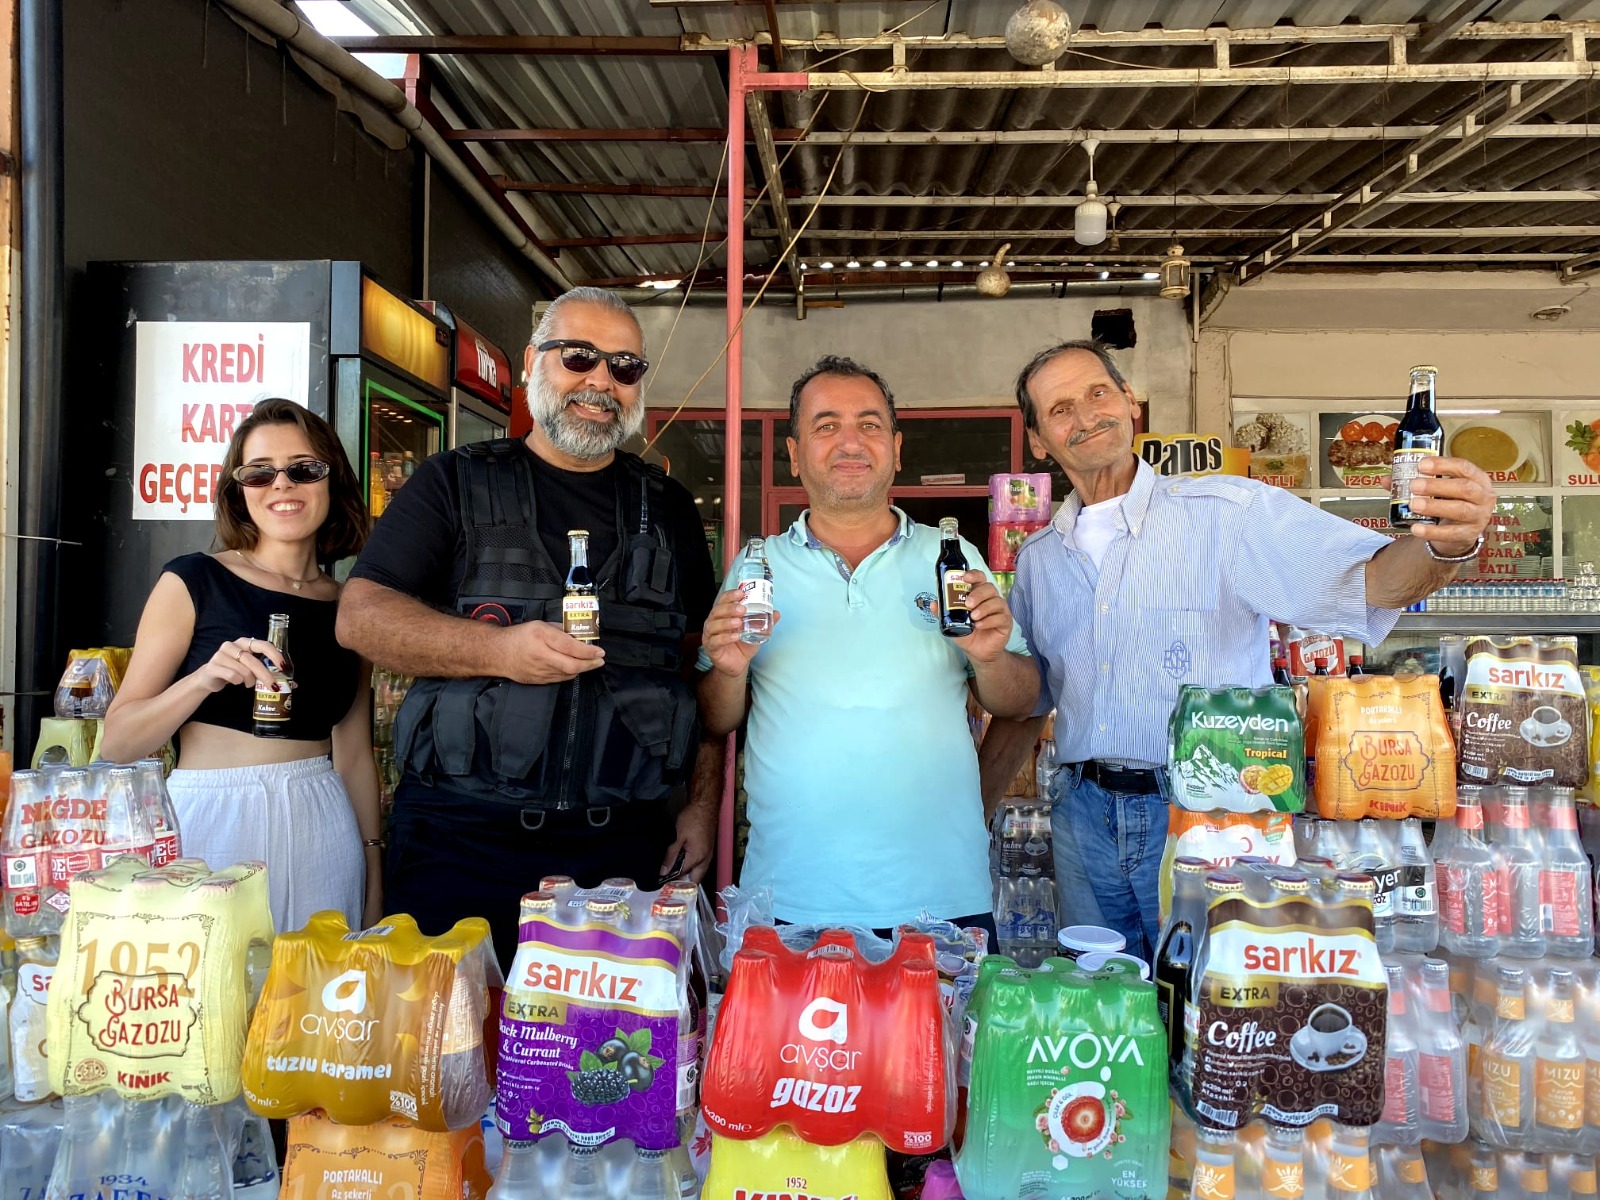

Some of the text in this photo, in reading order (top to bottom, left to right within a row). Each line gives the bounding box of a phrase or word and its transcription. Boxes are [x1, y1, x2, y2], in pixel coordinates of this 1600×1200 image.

[182, 333, 265, 383] KREDİ
[181, 403, 255, 443] KART
[1345, 475, 1382, 486] IZGA
[1488, 665, 1565, 689] sarıkız
[1471, 691, 1507, 702] EXTRA
[1191, 711, 1289, 735] Kuzeyden
[1466, 711, 1512, 734] Coffee
[1244, 747, 1288, 760] Tropical
[1360, 735, 1412, 761] BURSA
[1358, 760, 1415, 786] GAZOZU
[21, 793, 108, 825] NİĞDE
[21, 828, 108, 849] GAZOZU
[1244, 937, 1359, 975] sarıkız
[79, 938, 200, 999] 1952
[523, 961, 639, 1002] sarıkız
[105, 979, 179, 1017] BURSA
[1221, 986, 1271, 1002] EXTRA
[507, 1000, 559, 1019] EXTRA
[98, 1015, 181, 1048] GAZOZU
[300, 1013, 380, 1044] avşar
[520, 1026, 578, 1050] Mulberry
[1207, 1020, 1277, 1053] Coffee
[502, 1038, 561, 1058] & Currant
[780, 1043, 862, 1072] avşar
[1026, 1032, 1144, 1069] AVOYA
[117, 1071, 172, 1089] KINIK
[266, 1056, 392, 1080] tuzlu karamel
[770, 1077, 862, 1114] gazoz
[100, 1173, 150, 1187] 1934
[323, 1168, 383, 1185] PORTAKALLI
[785, 1177, 808, 1190] 1952
[1122, 1170, 1136, 1179] EN
